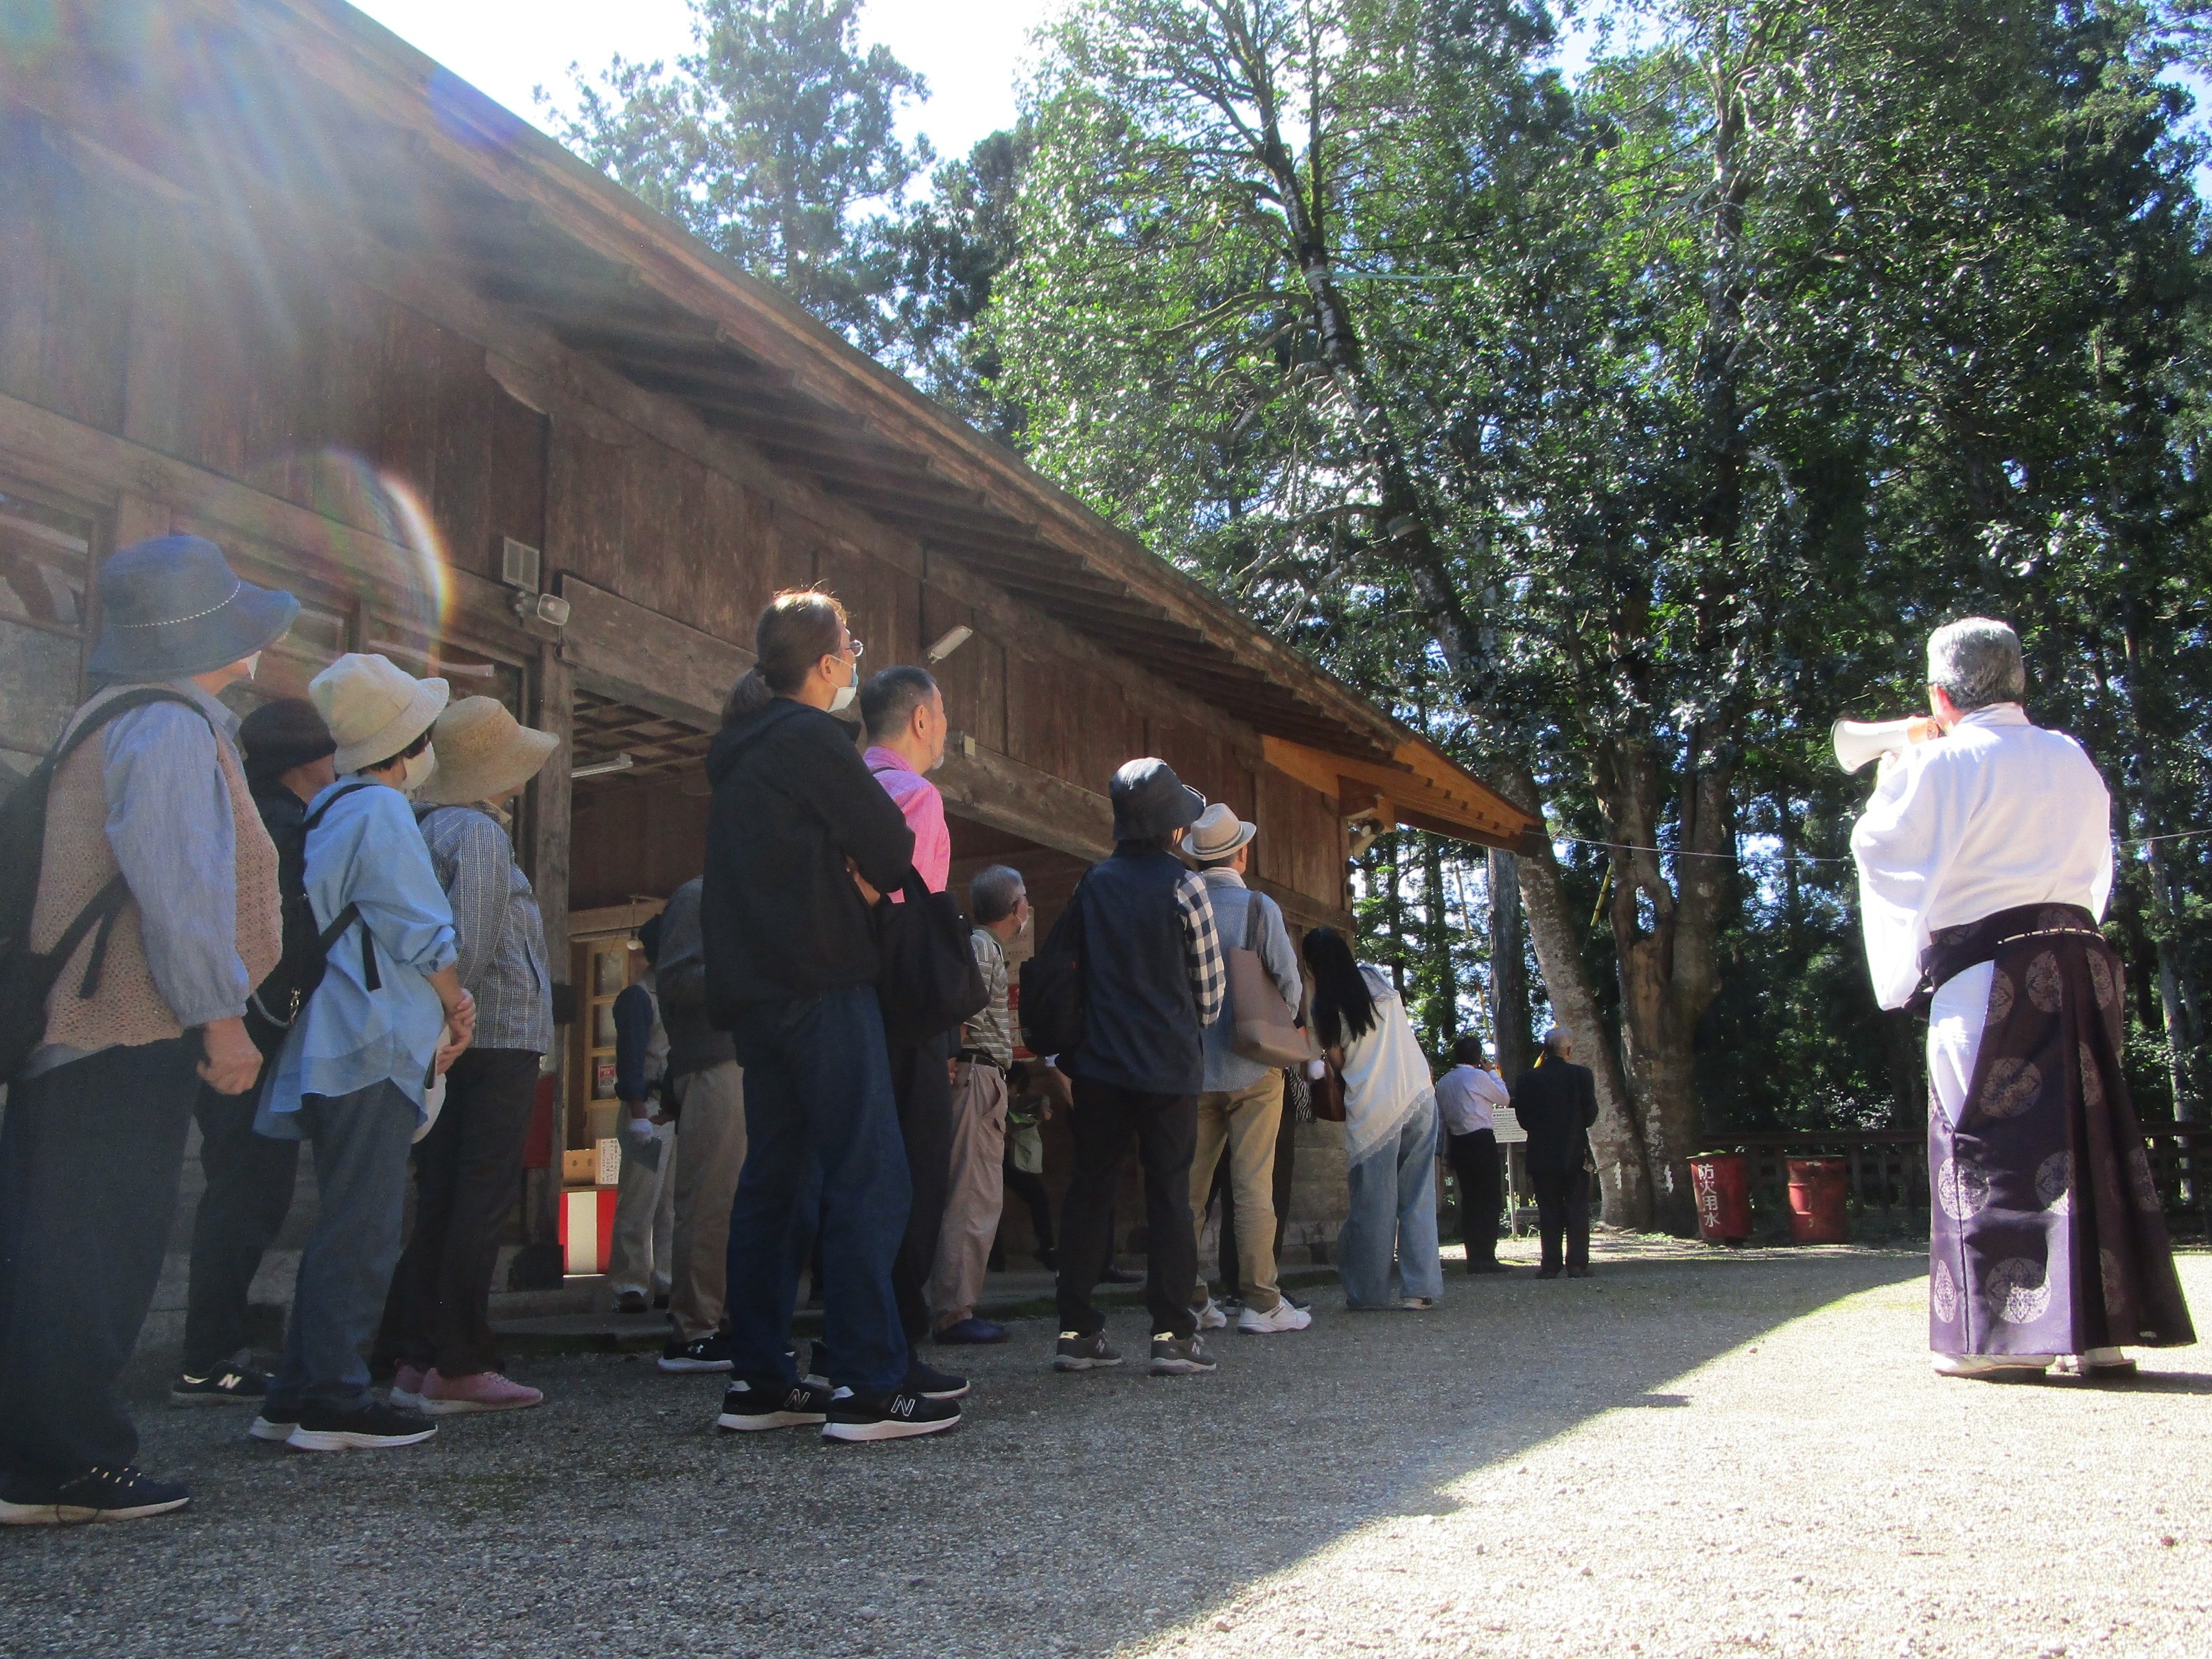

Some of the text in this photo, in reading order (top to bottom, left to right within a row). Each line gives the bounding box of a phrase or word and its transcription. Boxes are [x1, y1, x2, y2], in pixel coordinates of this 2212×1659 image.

[1698, 1163, 1721, 1227] 防火用水
[1191, 1341, 1201, 1356] N
[217, 1373, 243, 1390] N
[783, 1388, 811, 1411] N
[890, 1394, 916, 1417] N
